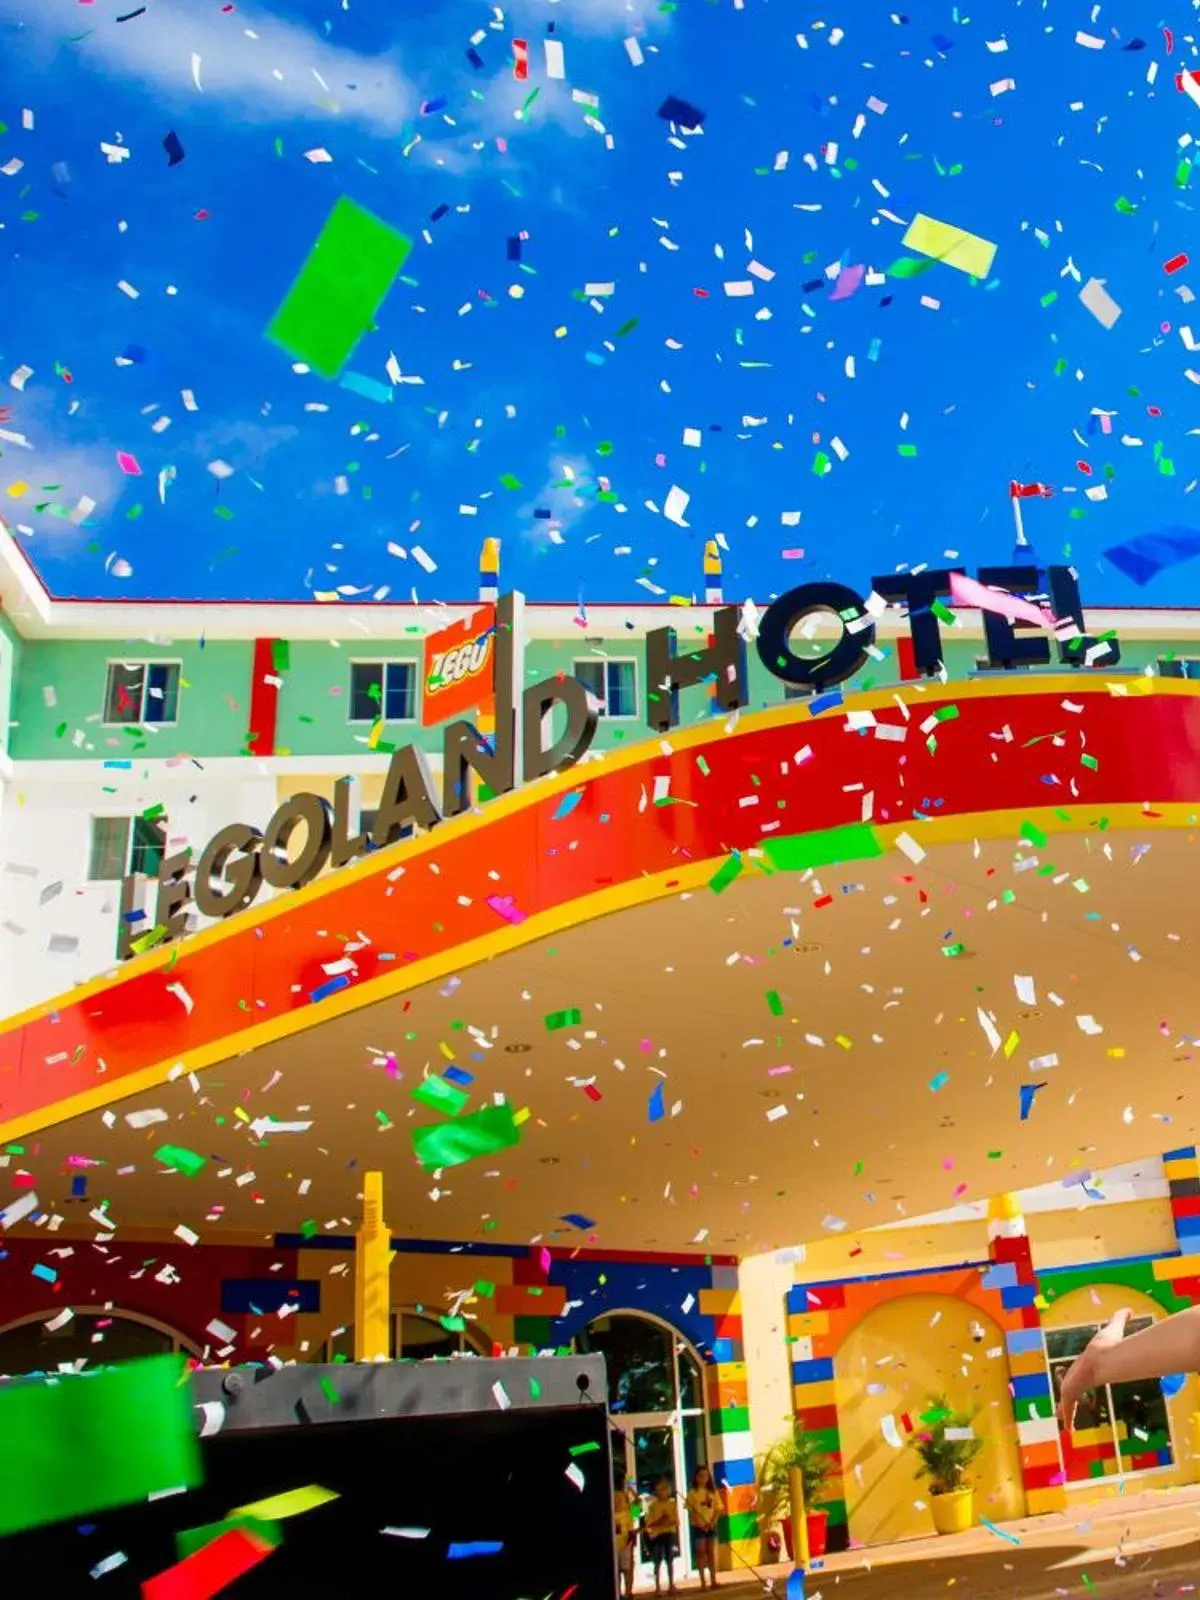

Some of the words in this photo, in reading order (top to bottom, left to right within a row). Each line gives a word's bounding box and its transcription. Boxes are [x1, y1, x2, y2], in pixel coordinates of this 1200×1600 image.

[117, 590, 598, 961] LEGOLAND
[646, 565, 1120, 732] HOTEL
[427, 635, 489, 692] LEGO
